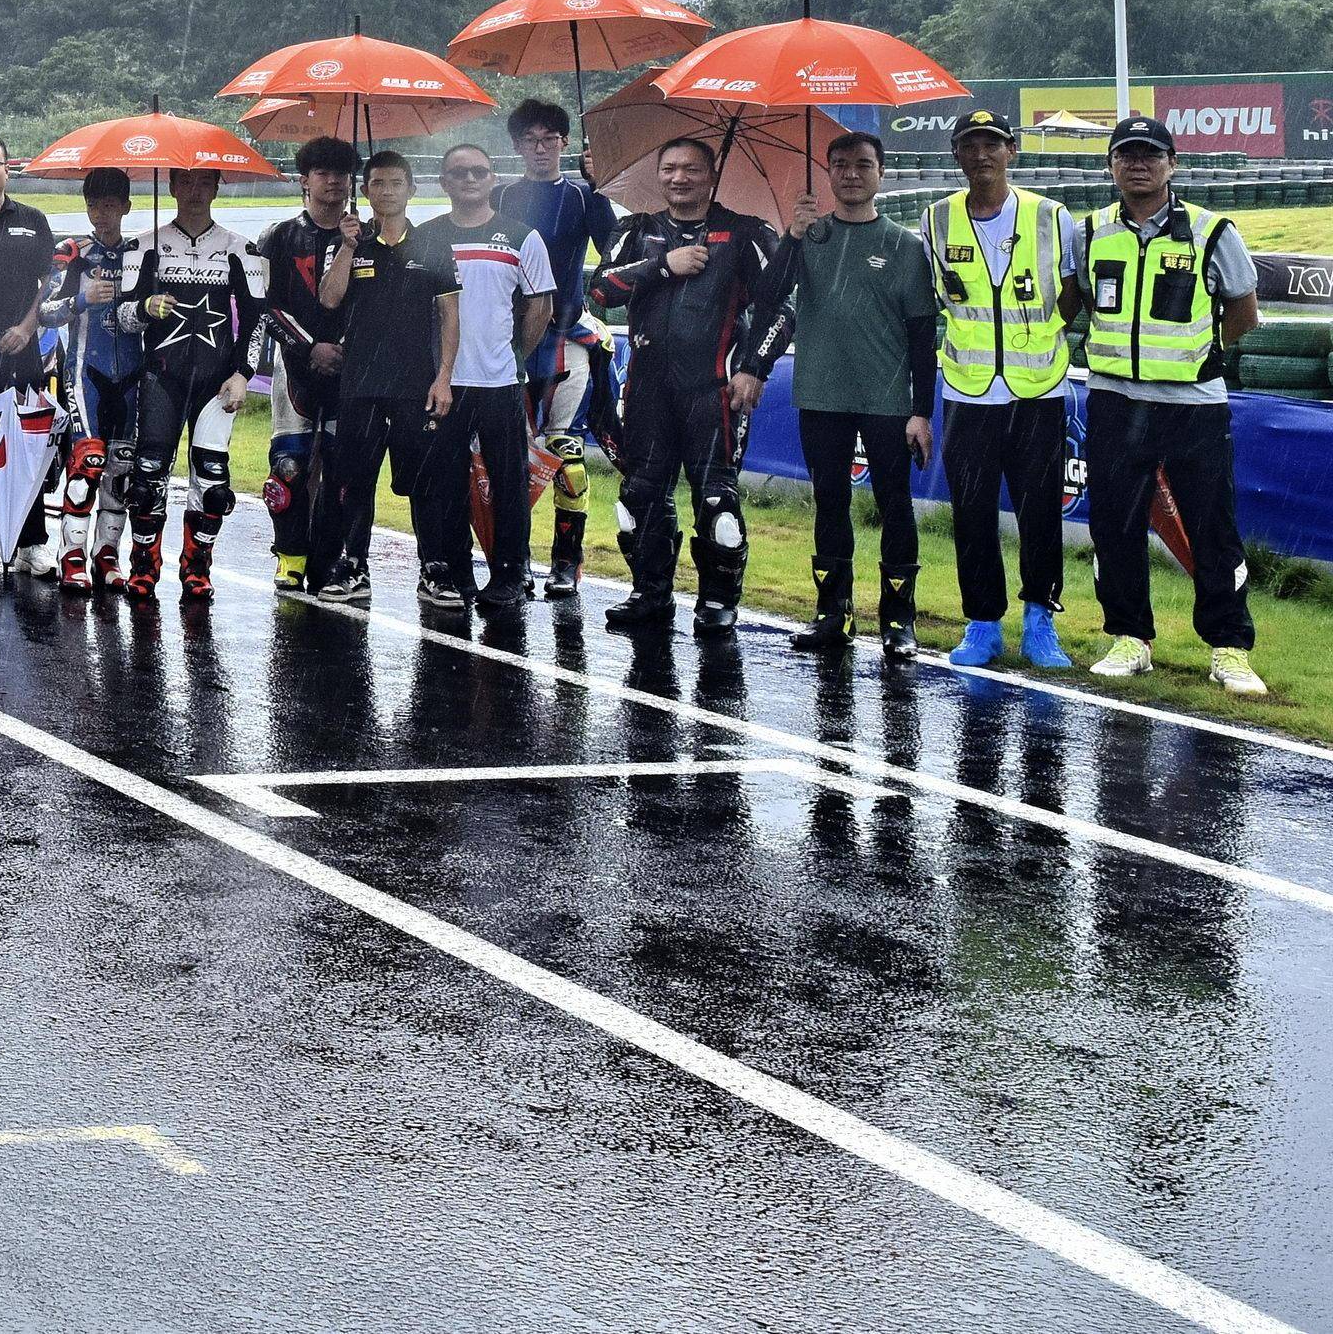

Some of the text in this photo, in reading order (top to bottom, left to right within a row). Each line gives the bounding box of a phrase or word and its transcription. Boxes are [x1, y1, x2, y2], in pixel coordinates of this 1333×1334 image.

[1165, 106, 1277, 135] MOTUL
[1303, 128, 1333, 141] hi
[947, 246, 974, 261] 裁判
[1164, 255, 1193, 271] 裁判
[90, 268, 123, 279] OHVA
[164, 266, 224, 279] BENKIA
[758, 315, 786, 357] speedhero
